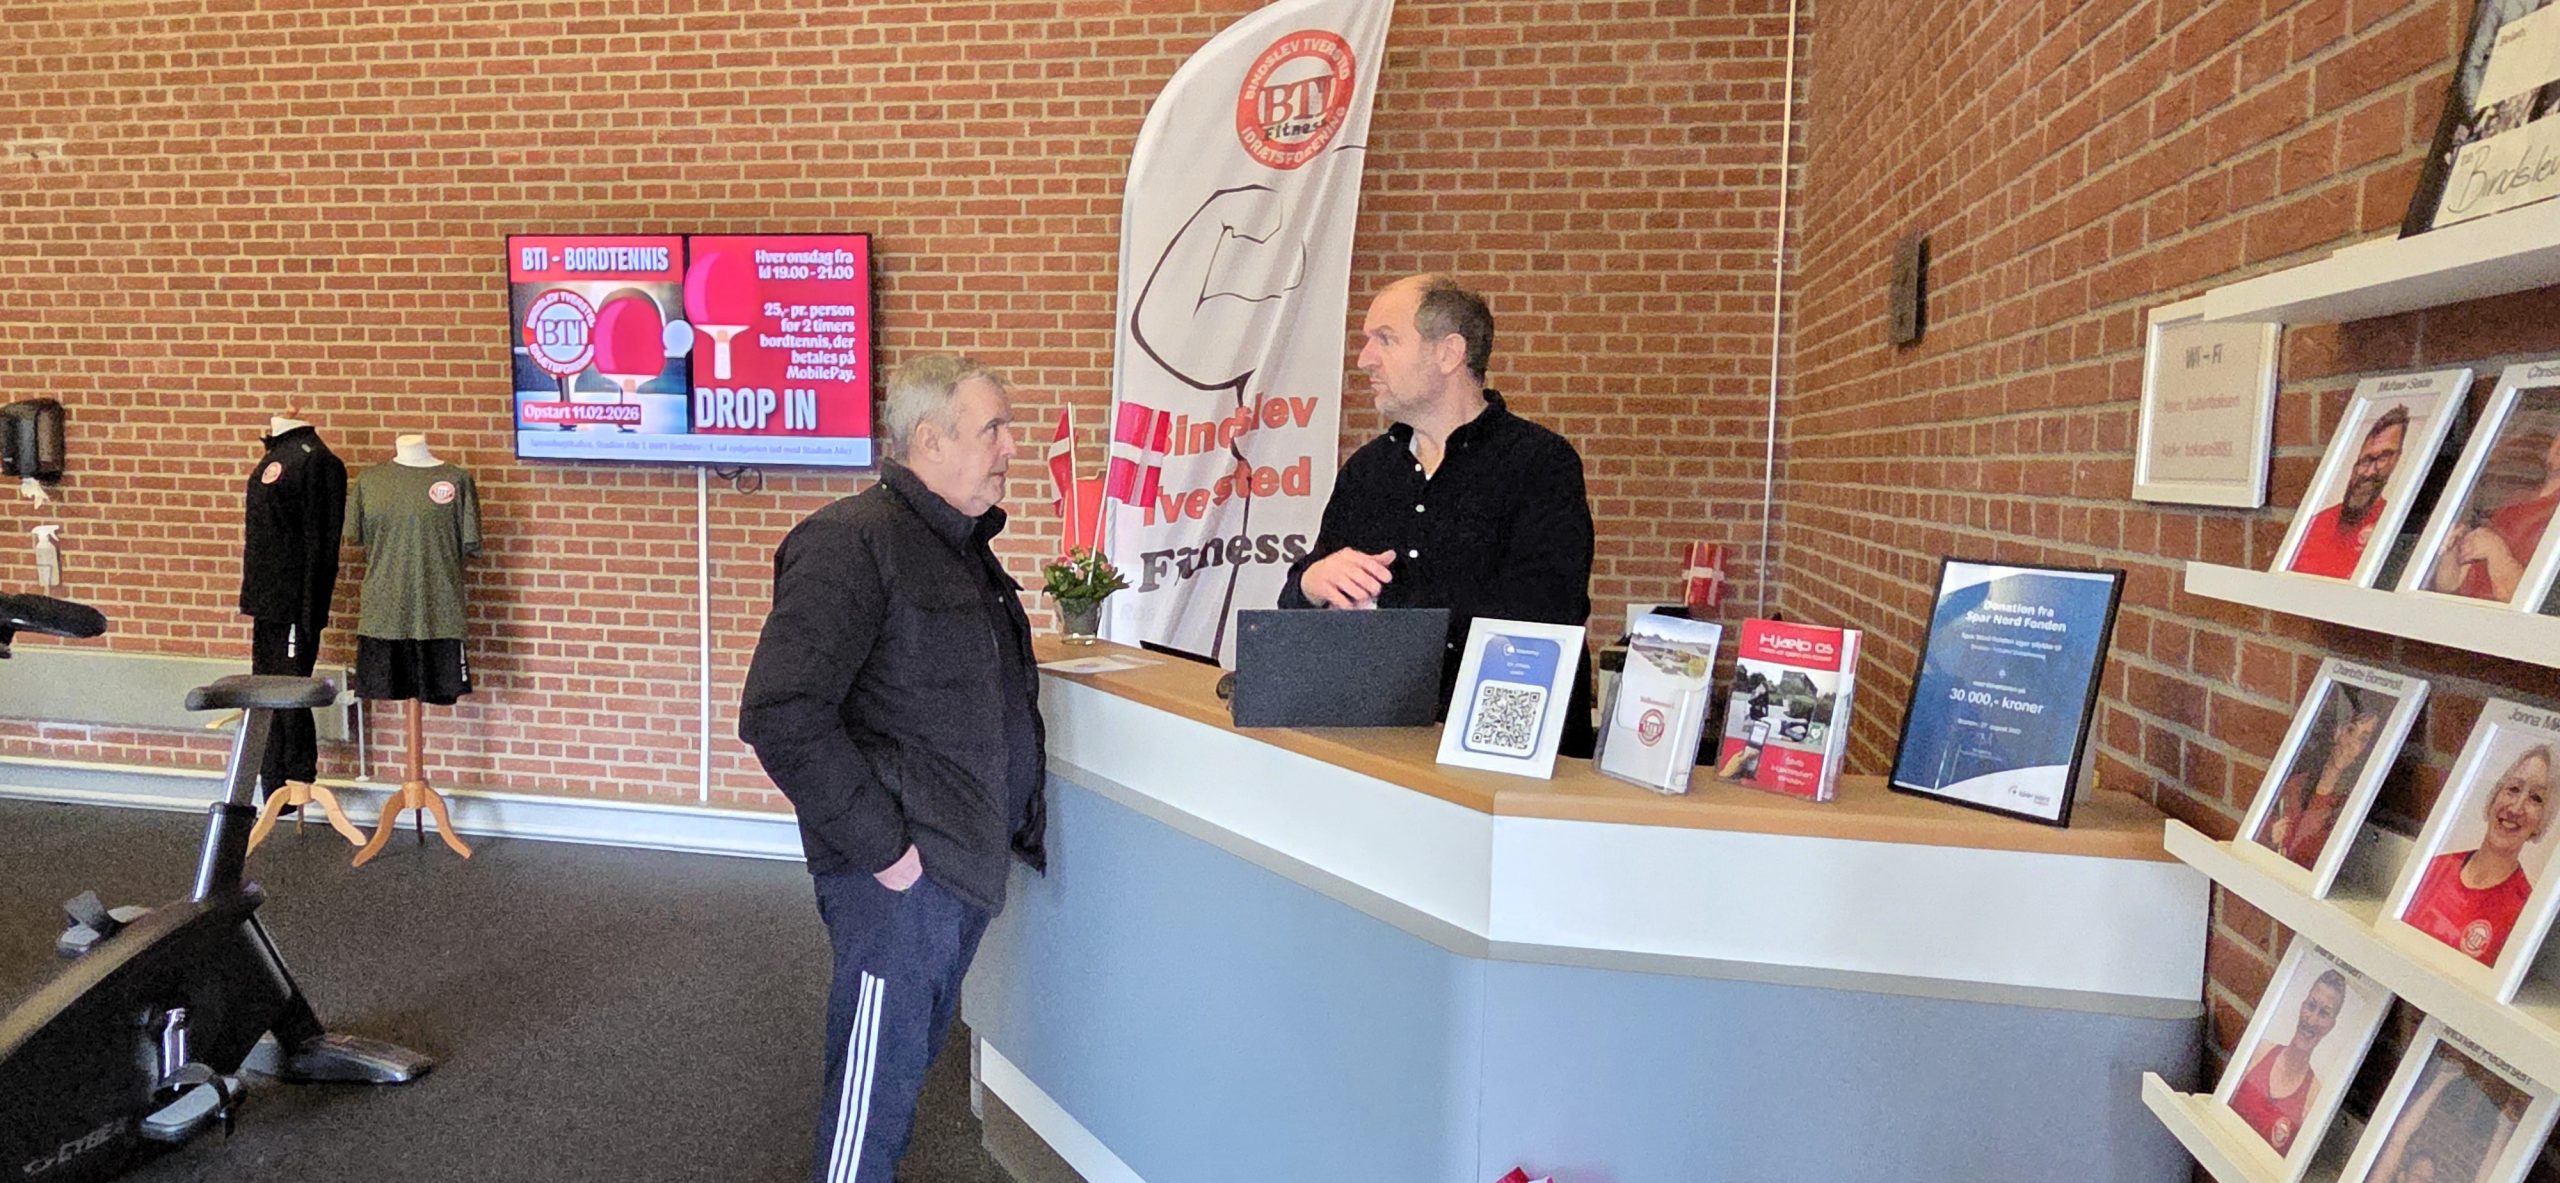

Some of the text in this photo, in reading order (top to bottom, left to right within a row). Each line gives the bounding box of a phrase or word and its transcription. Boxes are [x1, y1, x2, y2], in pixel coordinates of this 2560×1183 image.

[1244, 39, 1300, 100] BINDSLEV
[521, 246, 548, 271] BTI
[564, 246, 669, 272] BORDTENNIS
[755, 248, 855, 266] Hver onsdag fra
[772, 265, 809, 280] 19.00
[817, 265, 855, 280] 21.00
[790, 305, 809, 319] pr.
[809, 304, 856, 319] person
[540, 318, 586, 347] BTI
[780, 318, 856, 333] for 2 timers
[759, 333, 857, 350] bordtennis, der
[790, 349, 857, 367] betales på
[786, 365, 857, 383] MobilePay.
[523, 404, 641, 421] Opstart 11.02.2026
[694, 386, 818, 431] DROP IN
[1983, 599, 2055, 618] Donation fra
[1965, 610, 2067, 633] Spar Nord Fonden
[2001, 696, 2045, 714] kroner
